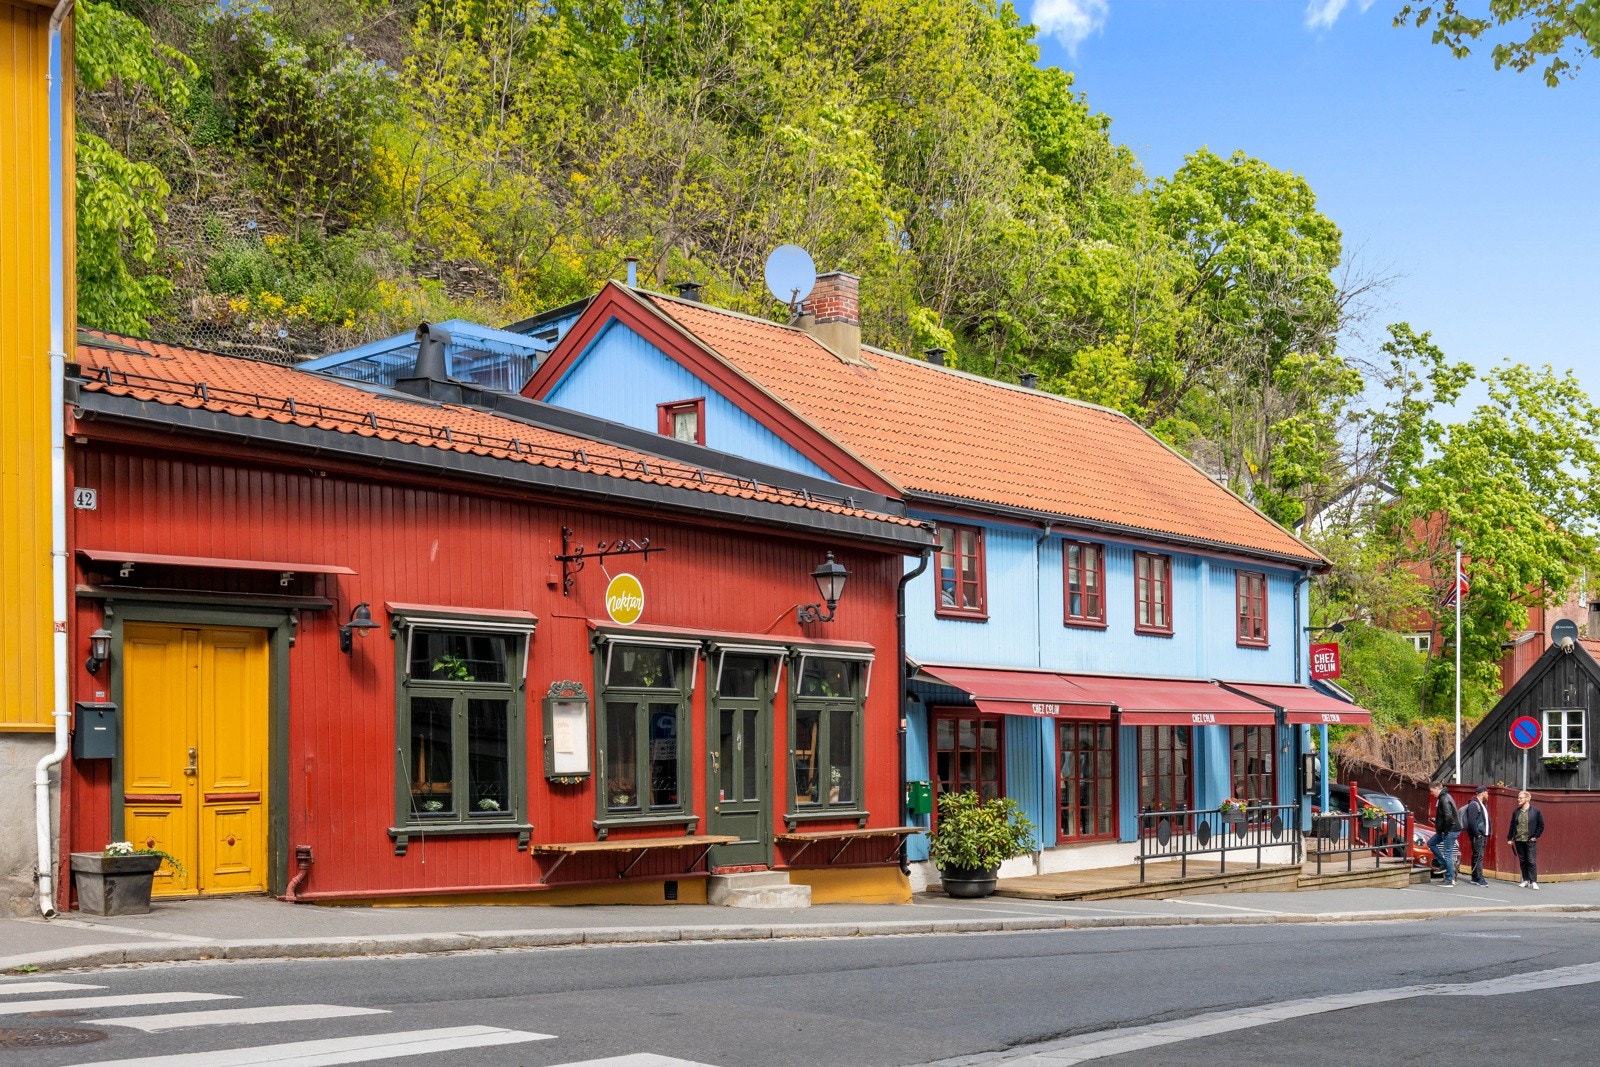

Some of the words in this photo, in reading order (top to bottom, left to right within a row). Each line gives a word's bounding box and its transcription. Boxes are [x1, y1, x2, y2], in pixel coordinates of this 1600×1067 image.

[76, 491, 92, 506] 42
[608, 590, 642, 612] nektar
[1314, 653, 1335, 663] CHEZ
[1032, 704, 1044, 714] CHEZ
[1192, 714, 1203, 722] CHEZ
